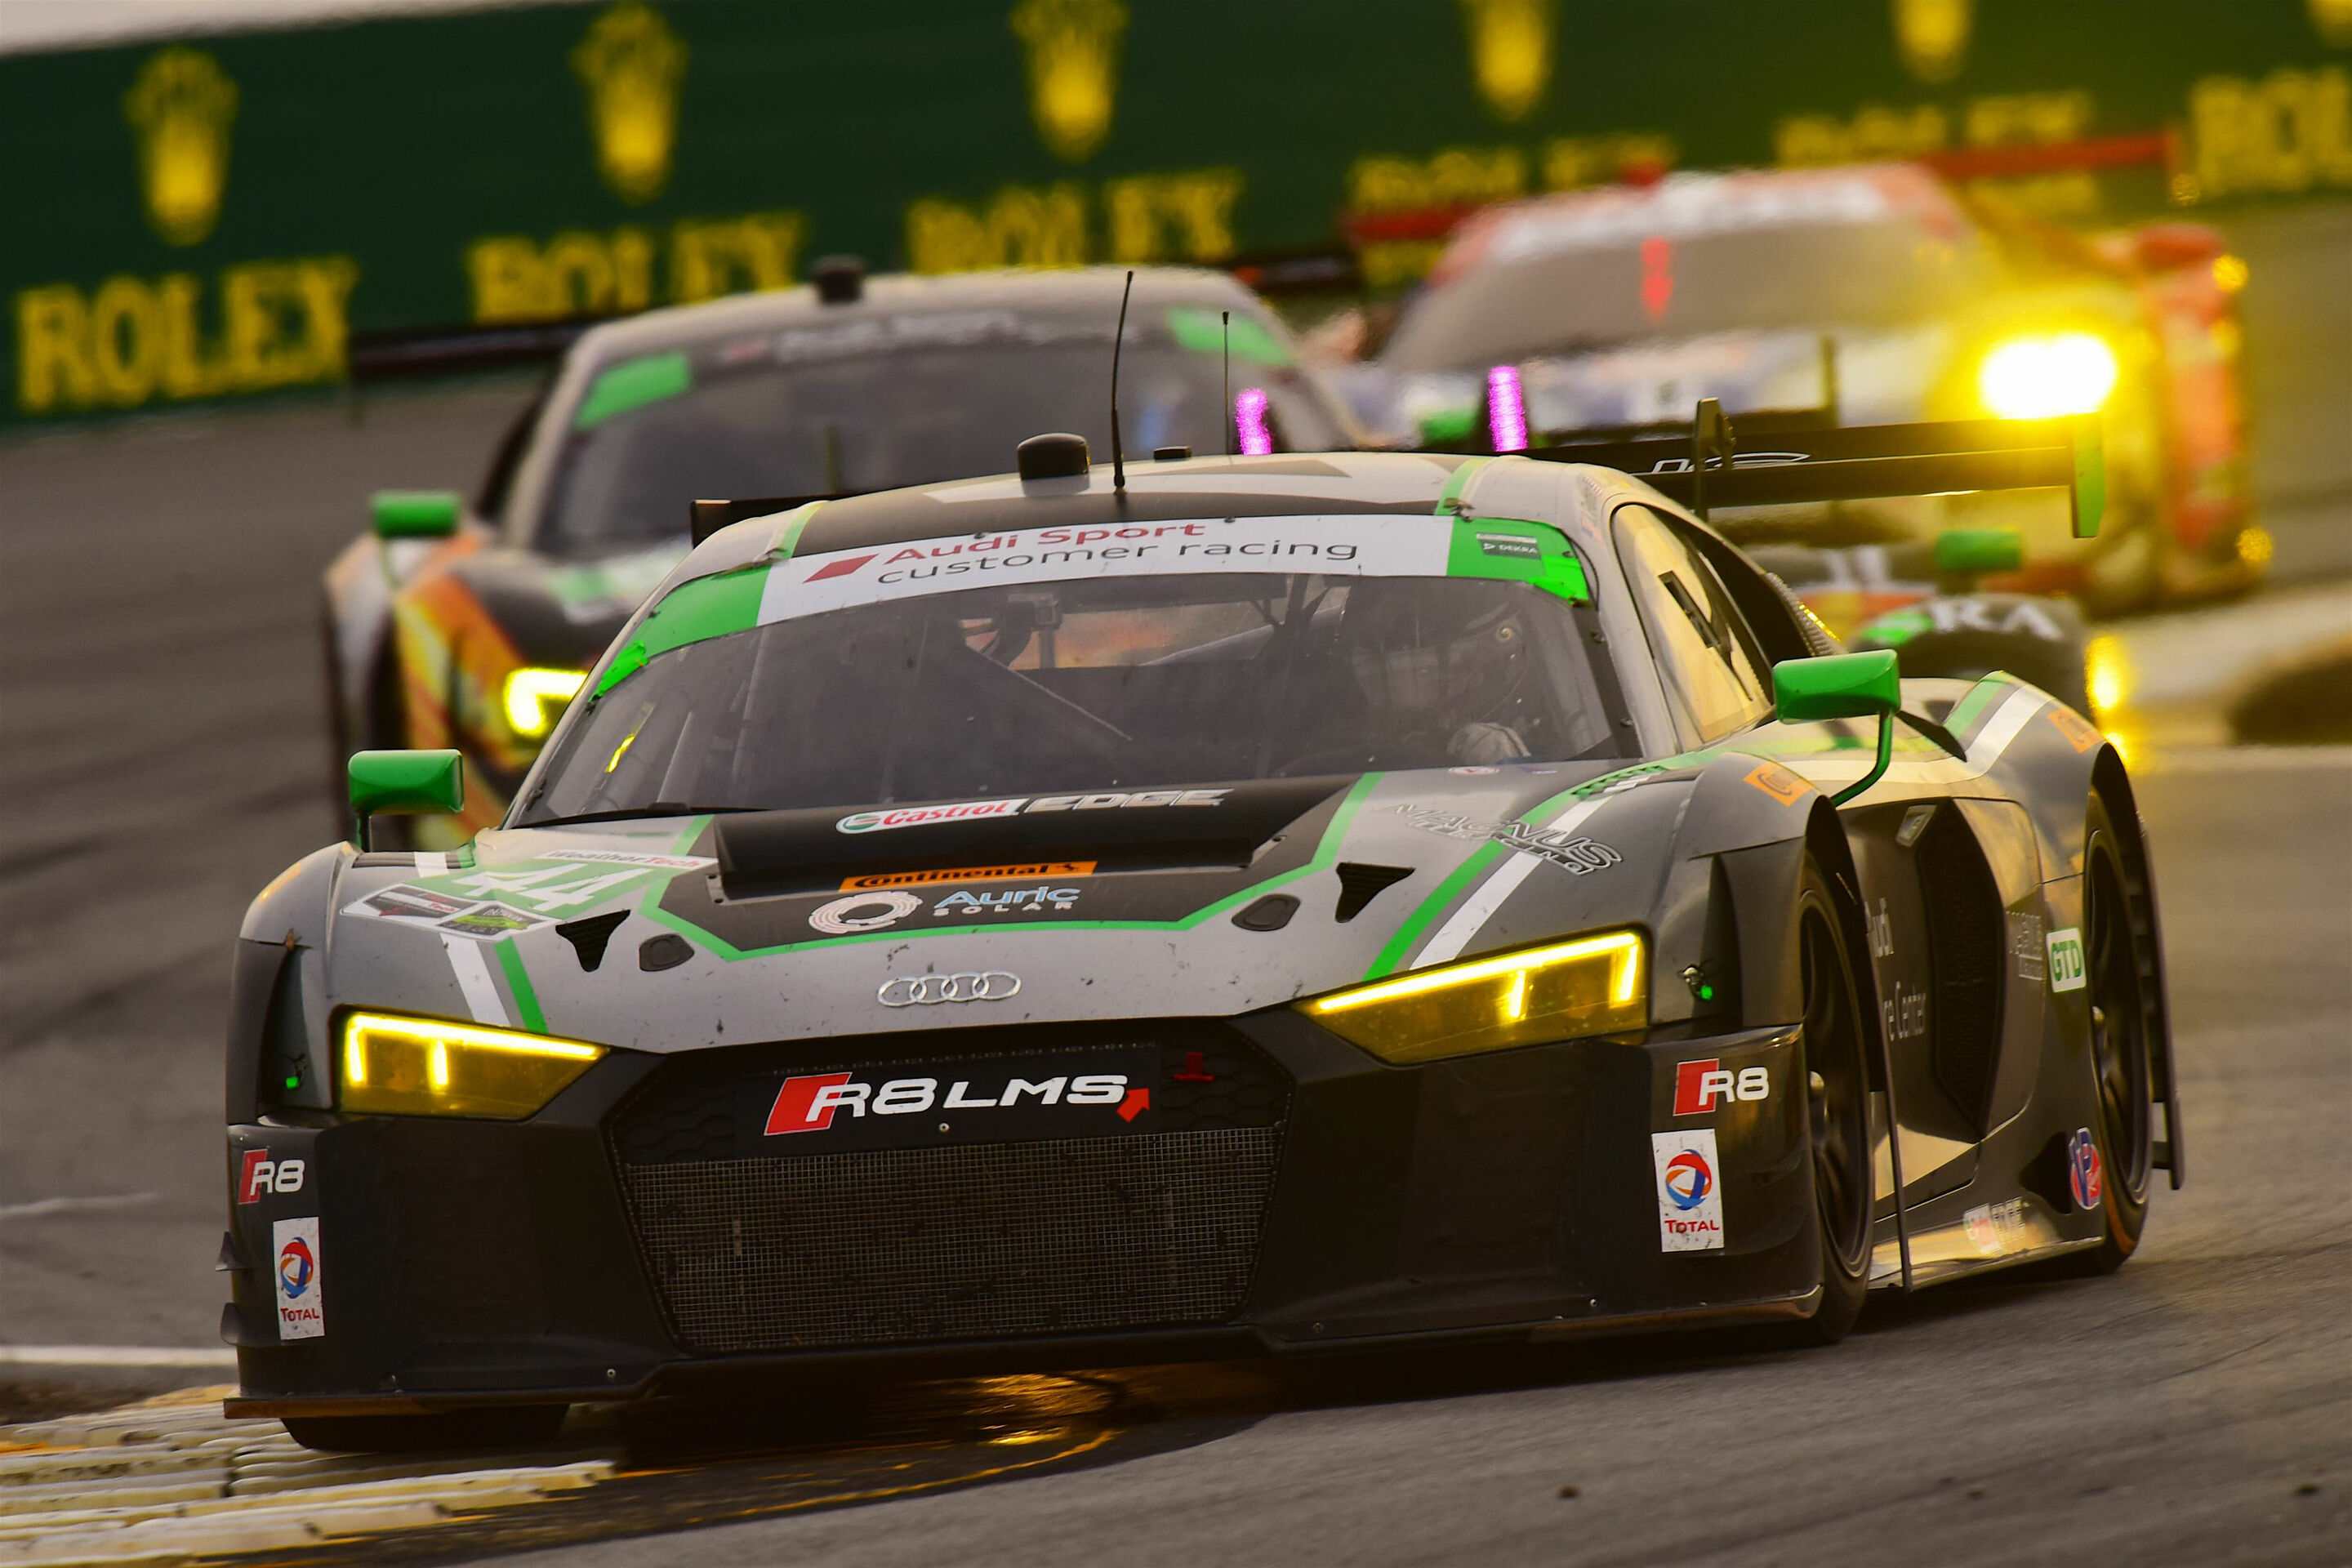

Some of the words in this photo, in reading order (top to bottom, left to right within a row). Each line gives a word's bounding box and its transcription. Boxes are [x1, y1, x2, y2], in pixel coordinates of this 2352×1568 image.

[15, 256, 357, 411] ROLEX
[877, 543, 1159, 585] customer
[1178, 537, 1359, 560] racing
[883, 534, 1018, 565] Audi
[1037, 523, 1206, 546] Sport
[883, 802, 1011, 826] Castrol
[1023, 788, 1236, 814] EDGE
[452, 862, 656, 912] 44
[853, 864, 1049, 889] Continental
[933, 886, 1081, 911] Auric
[933, 902, 1073, 917] SOLAR
[2051, 939, 2082, 982] GTD
[1698, 1067, 1770, 1106] R8
[249, 1159, 305, 1196] R8
[1664, 1218, 1721, 1234] TOTAL
[280, 1307, 320, 1322] TOTAL
